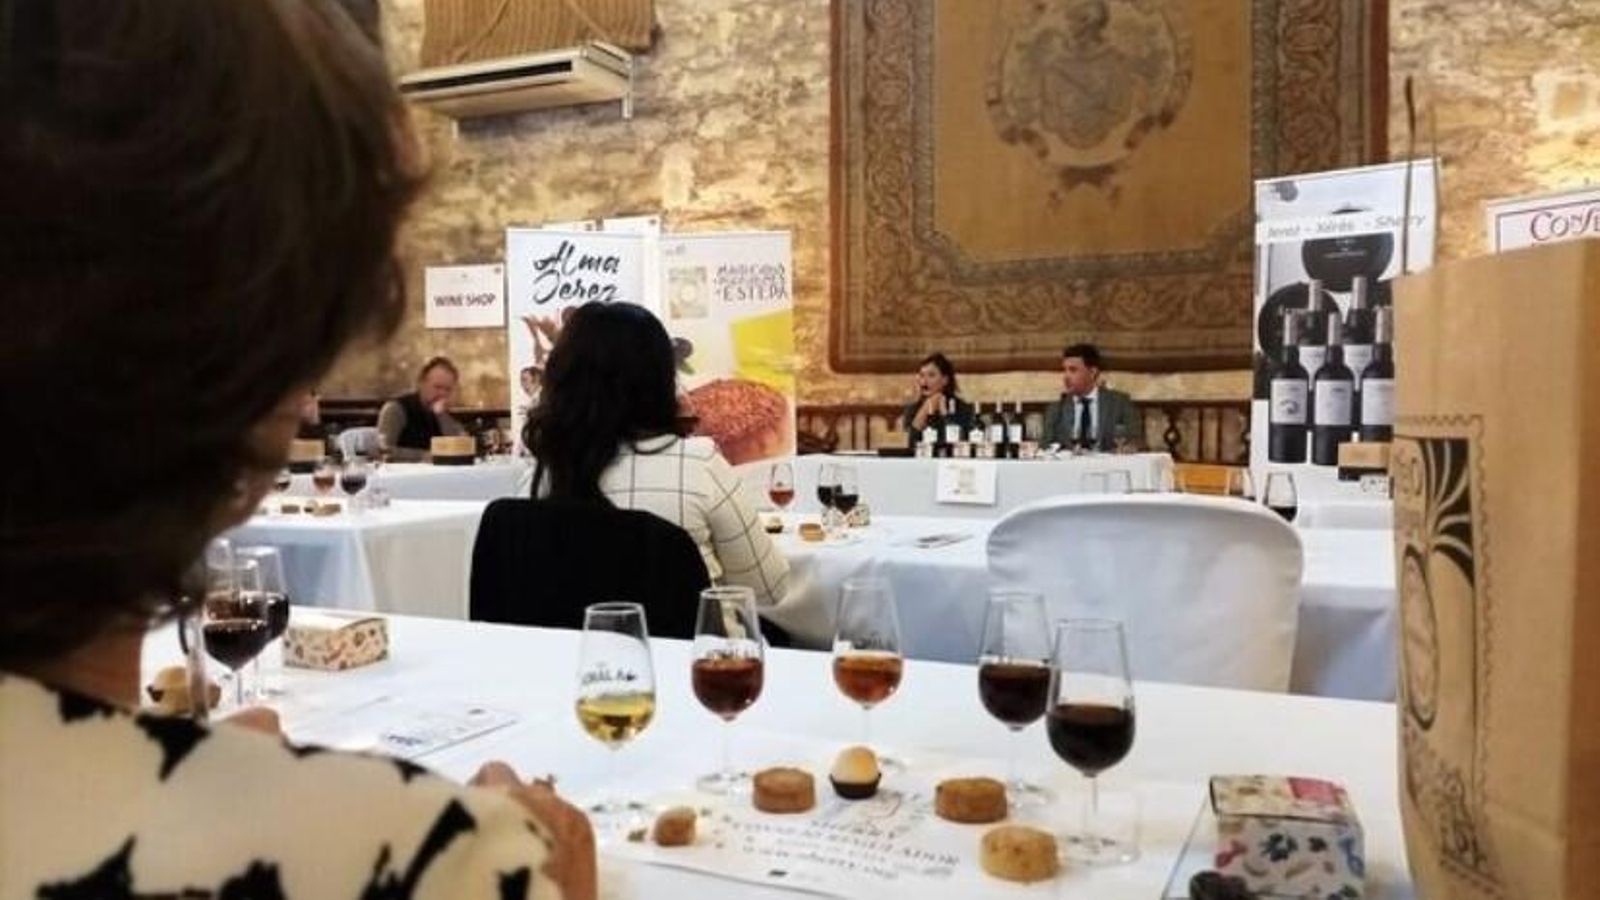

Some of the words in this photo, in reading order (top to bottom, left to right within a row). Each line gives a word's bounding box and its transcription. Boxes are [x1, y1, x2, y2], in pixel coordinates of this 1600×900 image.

[533, 240, 620, 277] Alma
[433, 295, 463, 308] WINE
[466, 292, 496, 308] SHOP
[533, 268, 619, 304] Jerez
